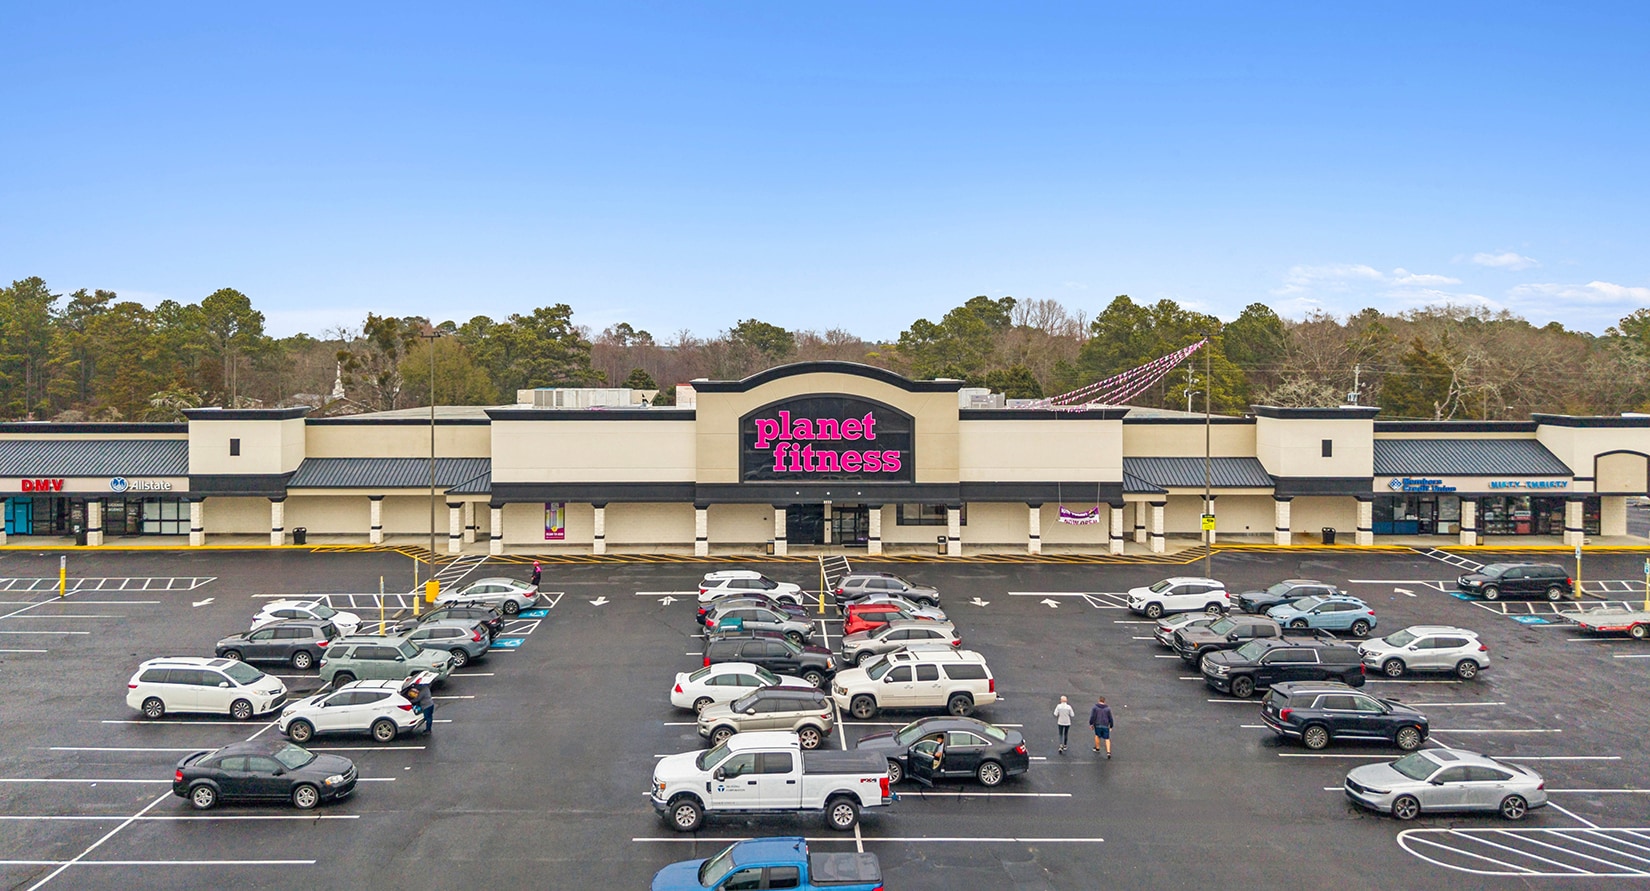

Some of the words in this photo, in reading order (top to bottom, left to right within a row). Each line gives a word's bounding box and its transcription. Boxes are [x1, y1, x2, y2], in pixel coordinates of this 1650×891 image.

[755, 410, 876, 449] planet
[773, 441, 902, 472] fitness
[21, 479, 63, 492] DMV
[130, 480, 171, 491] Allstate
[1491, 481, 1520, 489] NIFTY
[1525, 481, 1568, 489] THRIFTY
